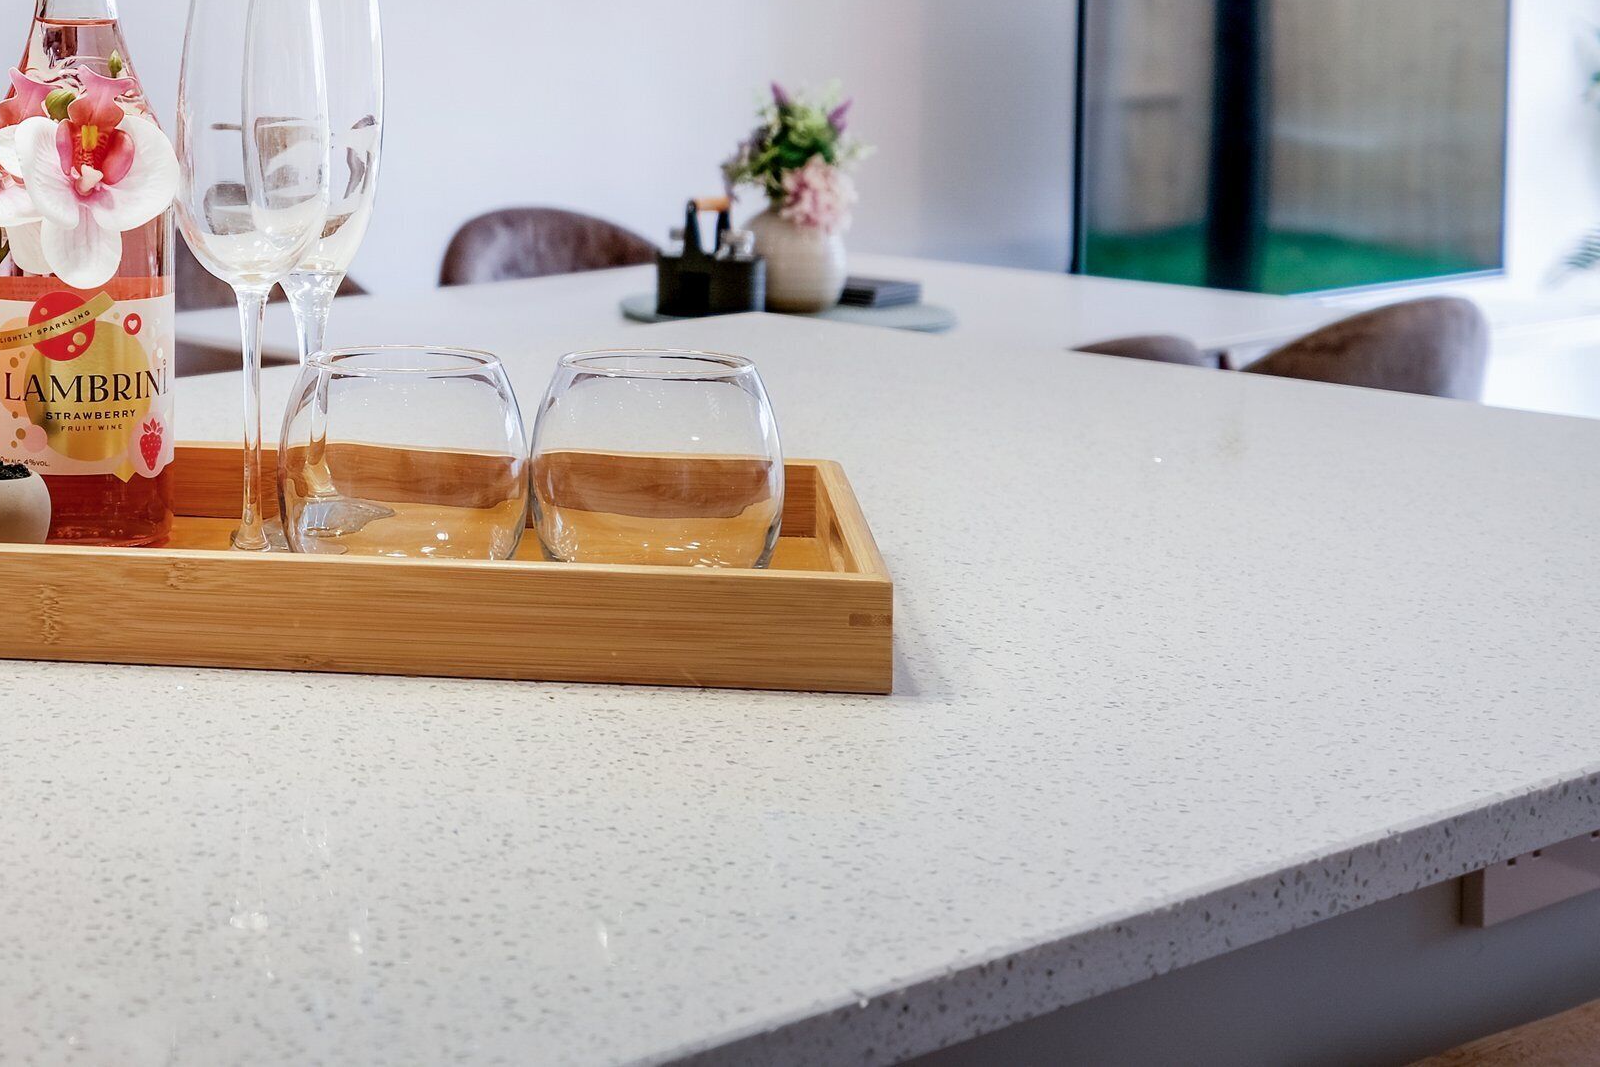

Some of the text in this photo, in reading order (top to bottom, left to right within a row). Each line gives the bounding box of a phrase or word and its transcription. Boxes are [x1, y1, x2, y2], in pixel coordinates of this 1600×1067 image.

[37, 310, 91, 335] SPARKLING
[45, 409, 136, 420] STRAWBERRY
[98, 423, 123, 431] WINE
